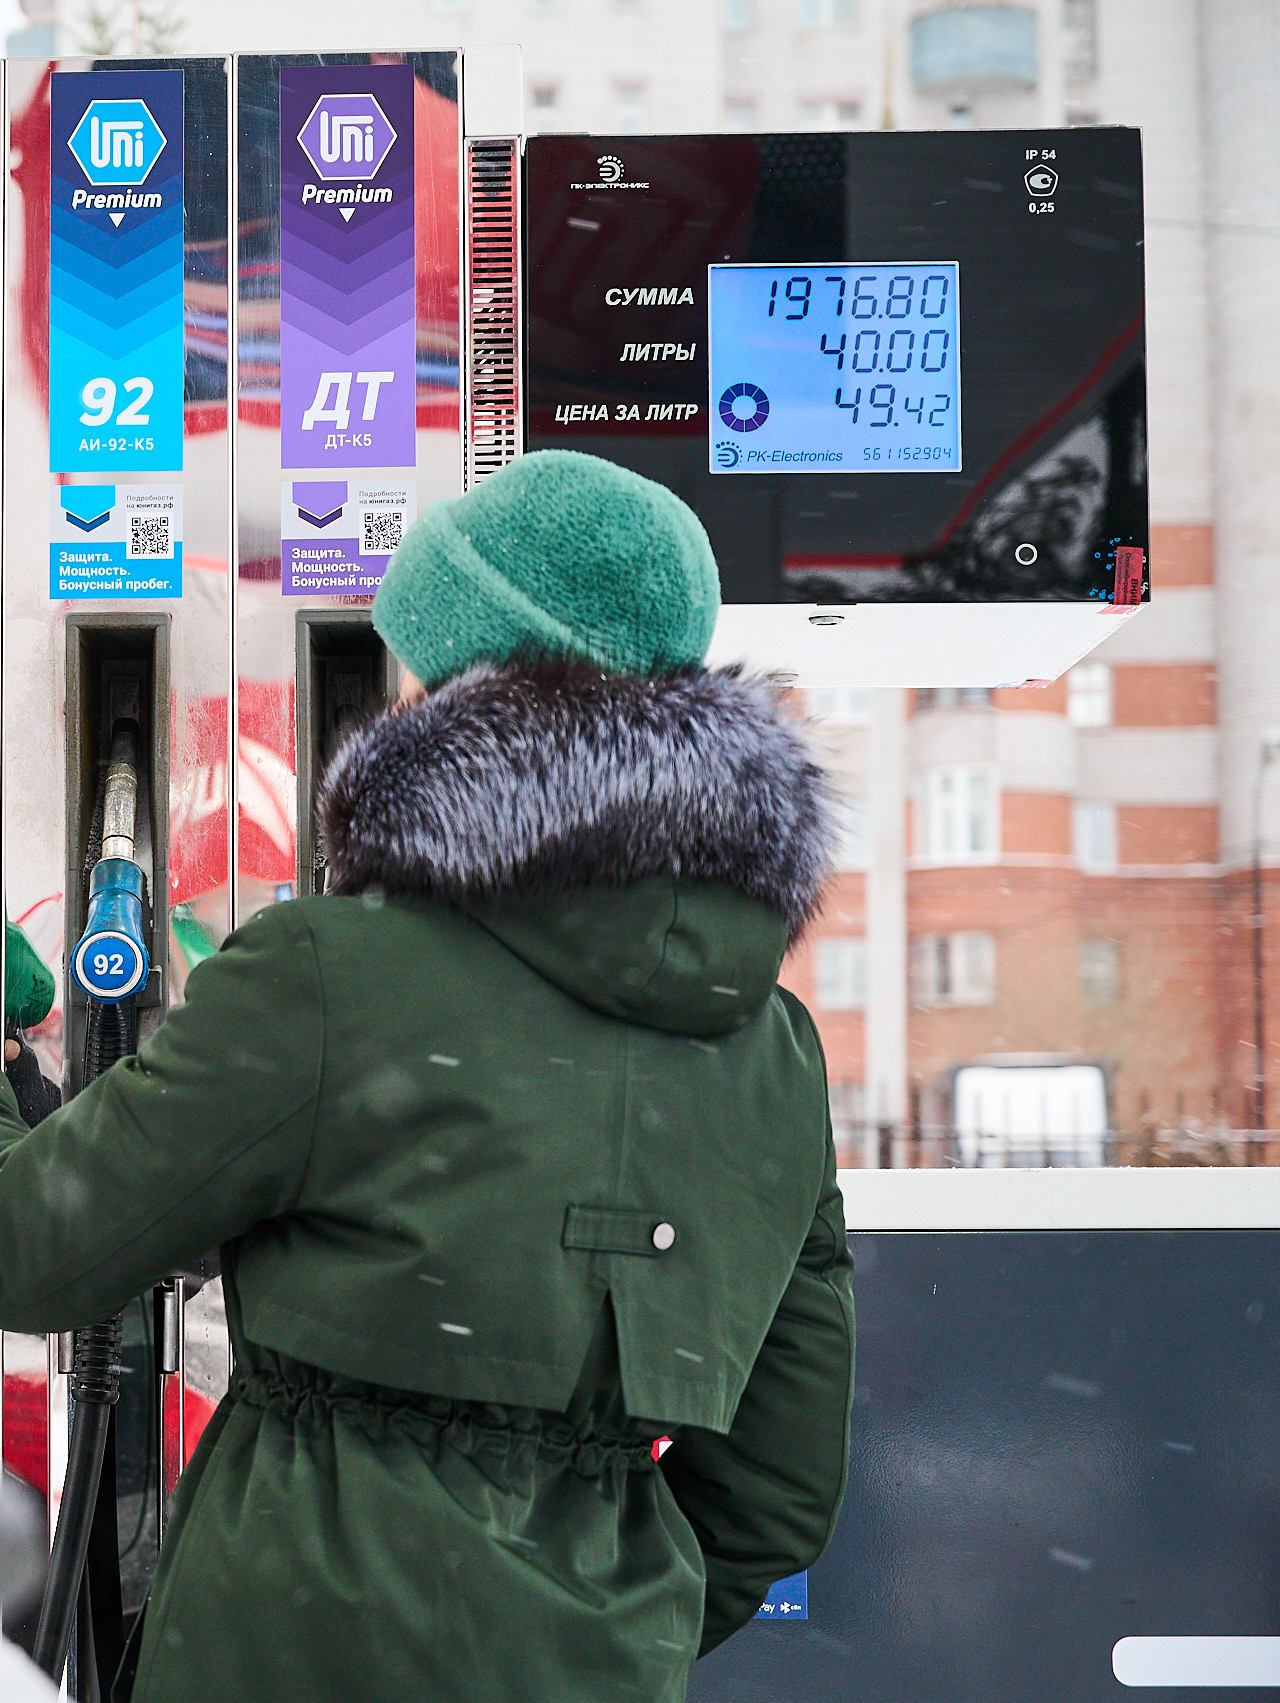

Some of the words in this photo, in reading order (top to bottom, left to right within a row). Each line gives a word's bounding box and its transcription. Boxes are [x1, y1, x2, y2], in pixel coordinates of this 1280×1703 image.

[1025, 149, 1038, 160] IP
[1041, 149, 1057, 160] 54
[72, 187, 162, 210] Premium
[302, 183, 393, 205] Premium
[1028, 202, 1055, 214] 0,25
[604, 287, 695, 306] СУММА
[767, 275, 949, 320] 1976.80
[619, 343, 696, 362] ЛИТРЫ
[820, 329, 951, 373] 40.00
[79, 376, 155, 426] 92
[301, 371, 395, 430] ДТ
[835, 384, 951, 428] 49.42
[555, 404, 610, 424] ЦЕНА
[614, 404, 642, 421] ЗА
[645, 403, 699, 421] ЛИТР
[79, 437, 155, 453] АИ-92-К5
[325, 434, 372, 450] ДТ-К5
[747, 450, 844, 462] PK-Electronics
[59, 550, 113, 565] Защита.
[291, 547, 346, 561] Защита.
[59, 564, 131, 578] Мощность.
[291, 561, 364, 575] Мощность.
[59, 577, 123, 592] Бонусный
[125, 577, 173, 592] пробег.
[291, 574, 356, 590] Бонусный
[93, 952, 125, 975] 92
